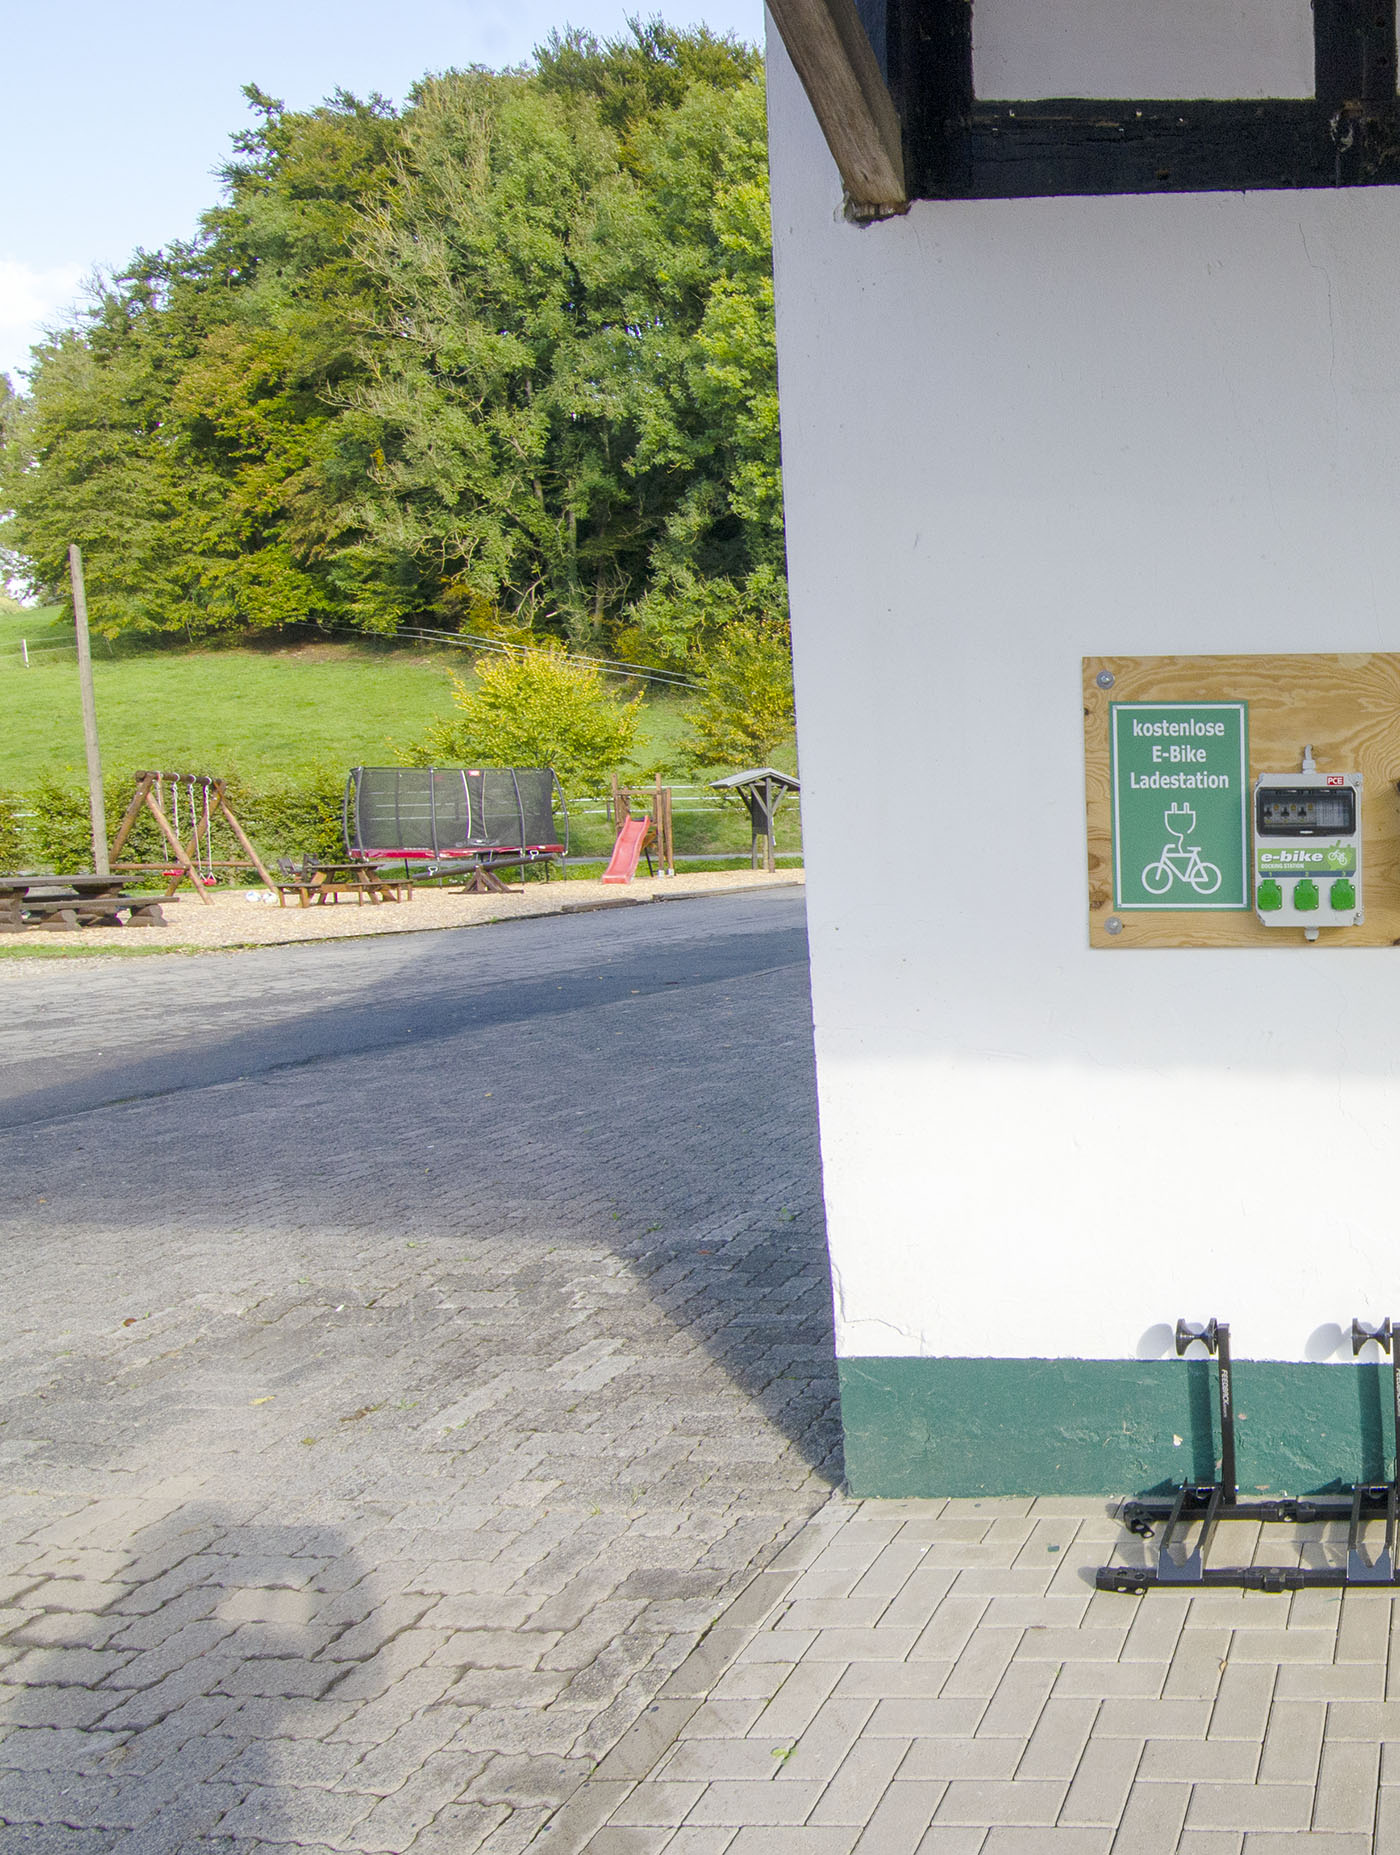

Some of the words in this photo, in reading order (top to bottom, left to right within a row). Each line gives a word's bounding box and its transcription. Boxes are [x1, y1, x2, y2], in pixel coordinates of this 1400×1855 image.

[1132, 718, 1225, 737] kostenlose
[1152, 744, 1207, 763] E-Bike
[1130, 770, 1229, 789] Ladestation
[1327, 777, 1343, 785] PCE
[1260, 850, 1324, 862] e-bike
